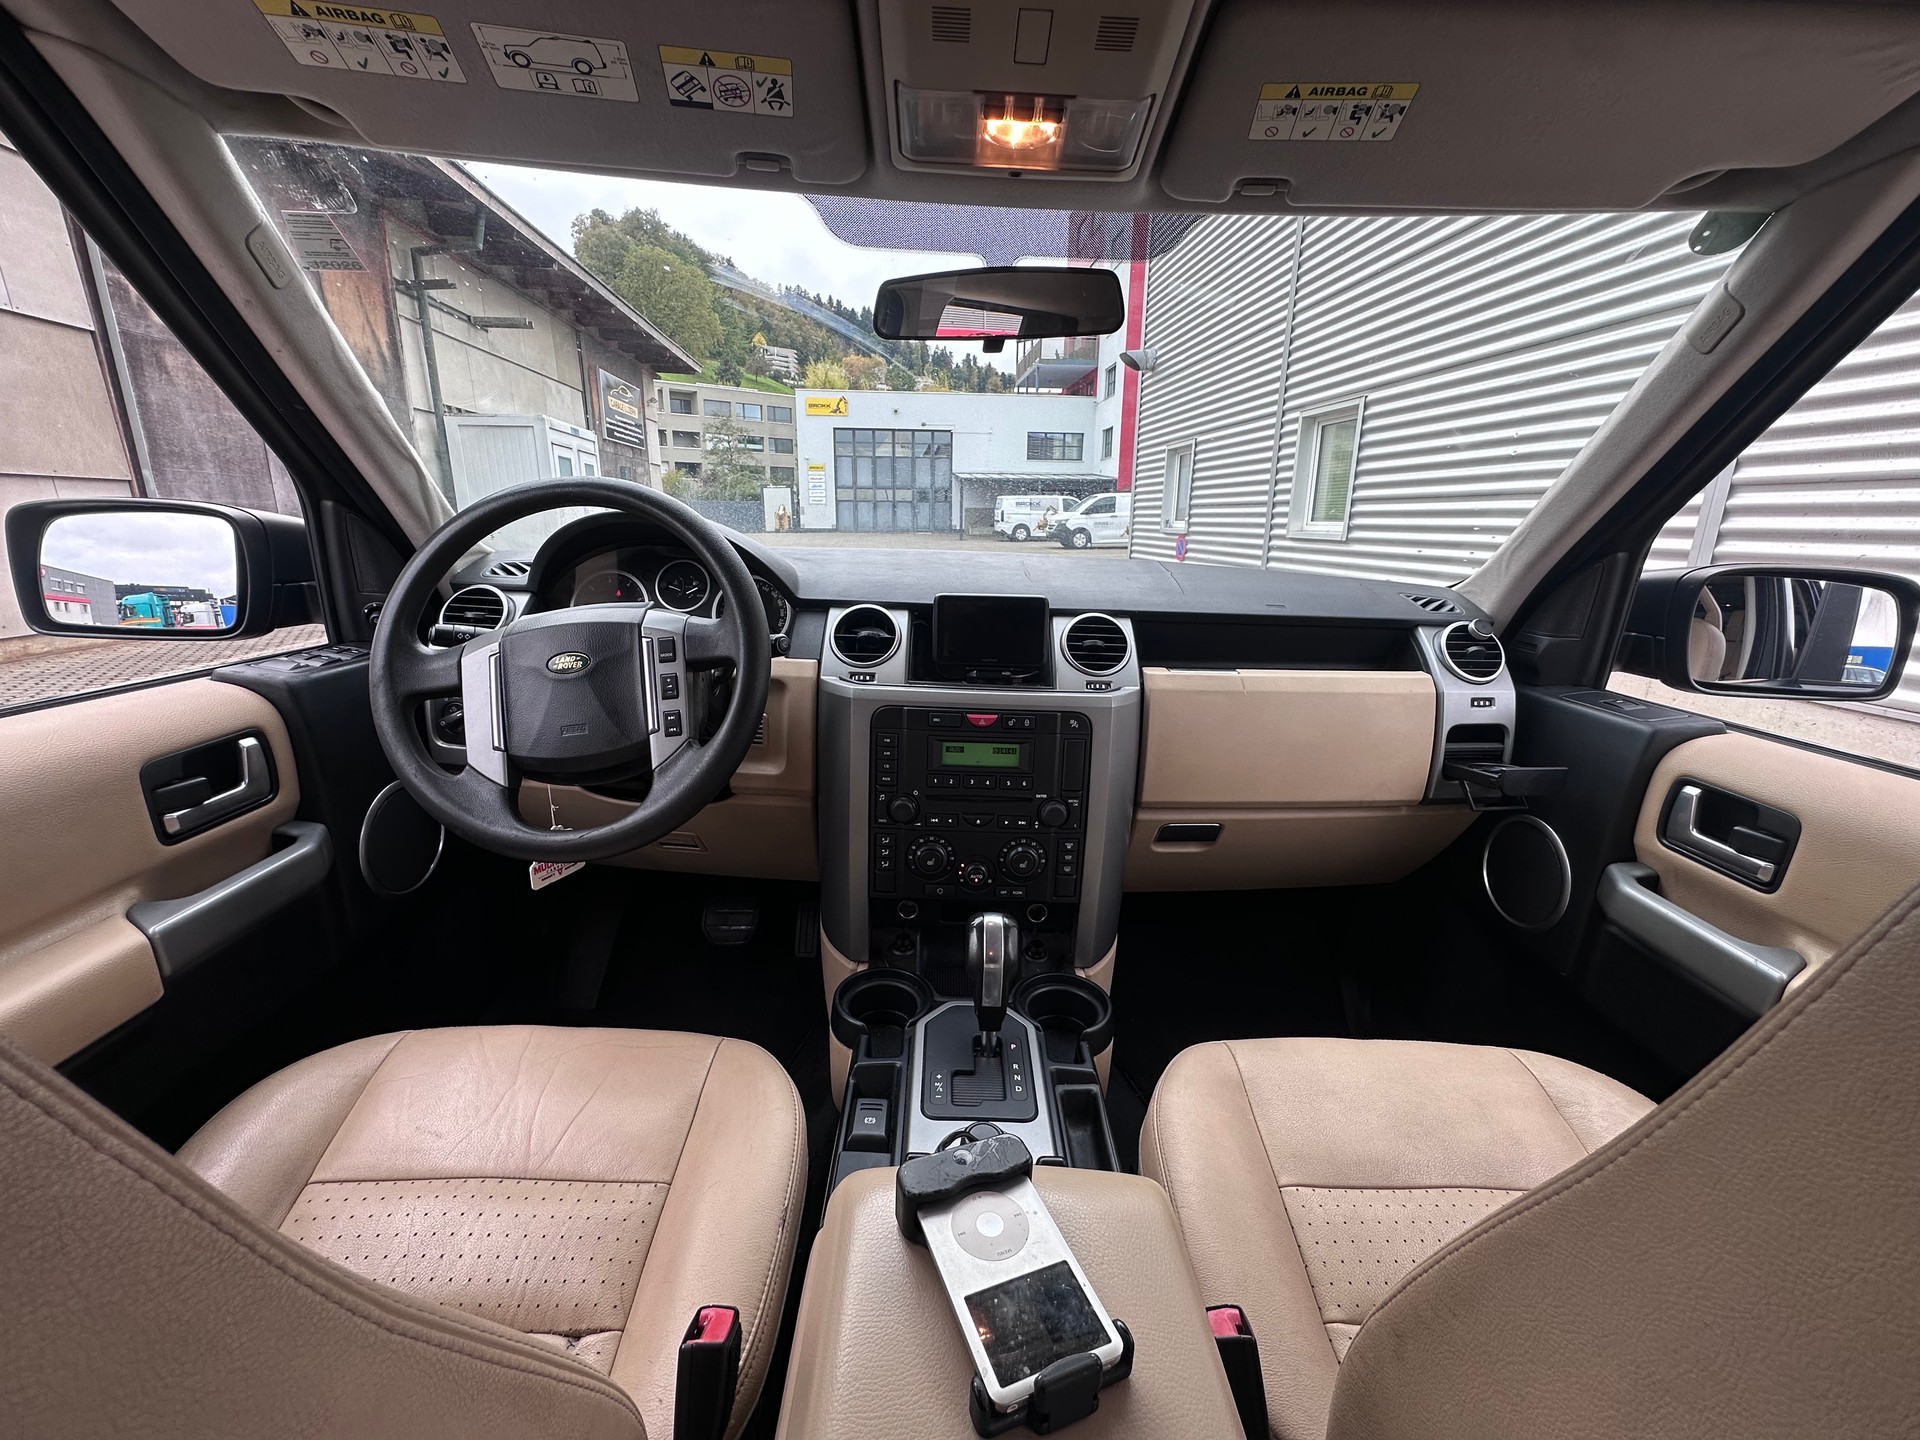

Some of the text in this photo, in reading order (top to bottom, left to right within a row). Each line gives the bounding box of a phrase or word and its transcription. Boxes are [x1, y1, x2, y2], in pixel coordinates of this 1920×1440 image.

[314, 5, 387, 25] AIRBAG
[1307, 86, 1369, 97] AIRBAG
[555, 655, 576, 664] LAND
[557, 661, 583, 671] ROVER
[996, 1248, 1013, 1257] MENU
